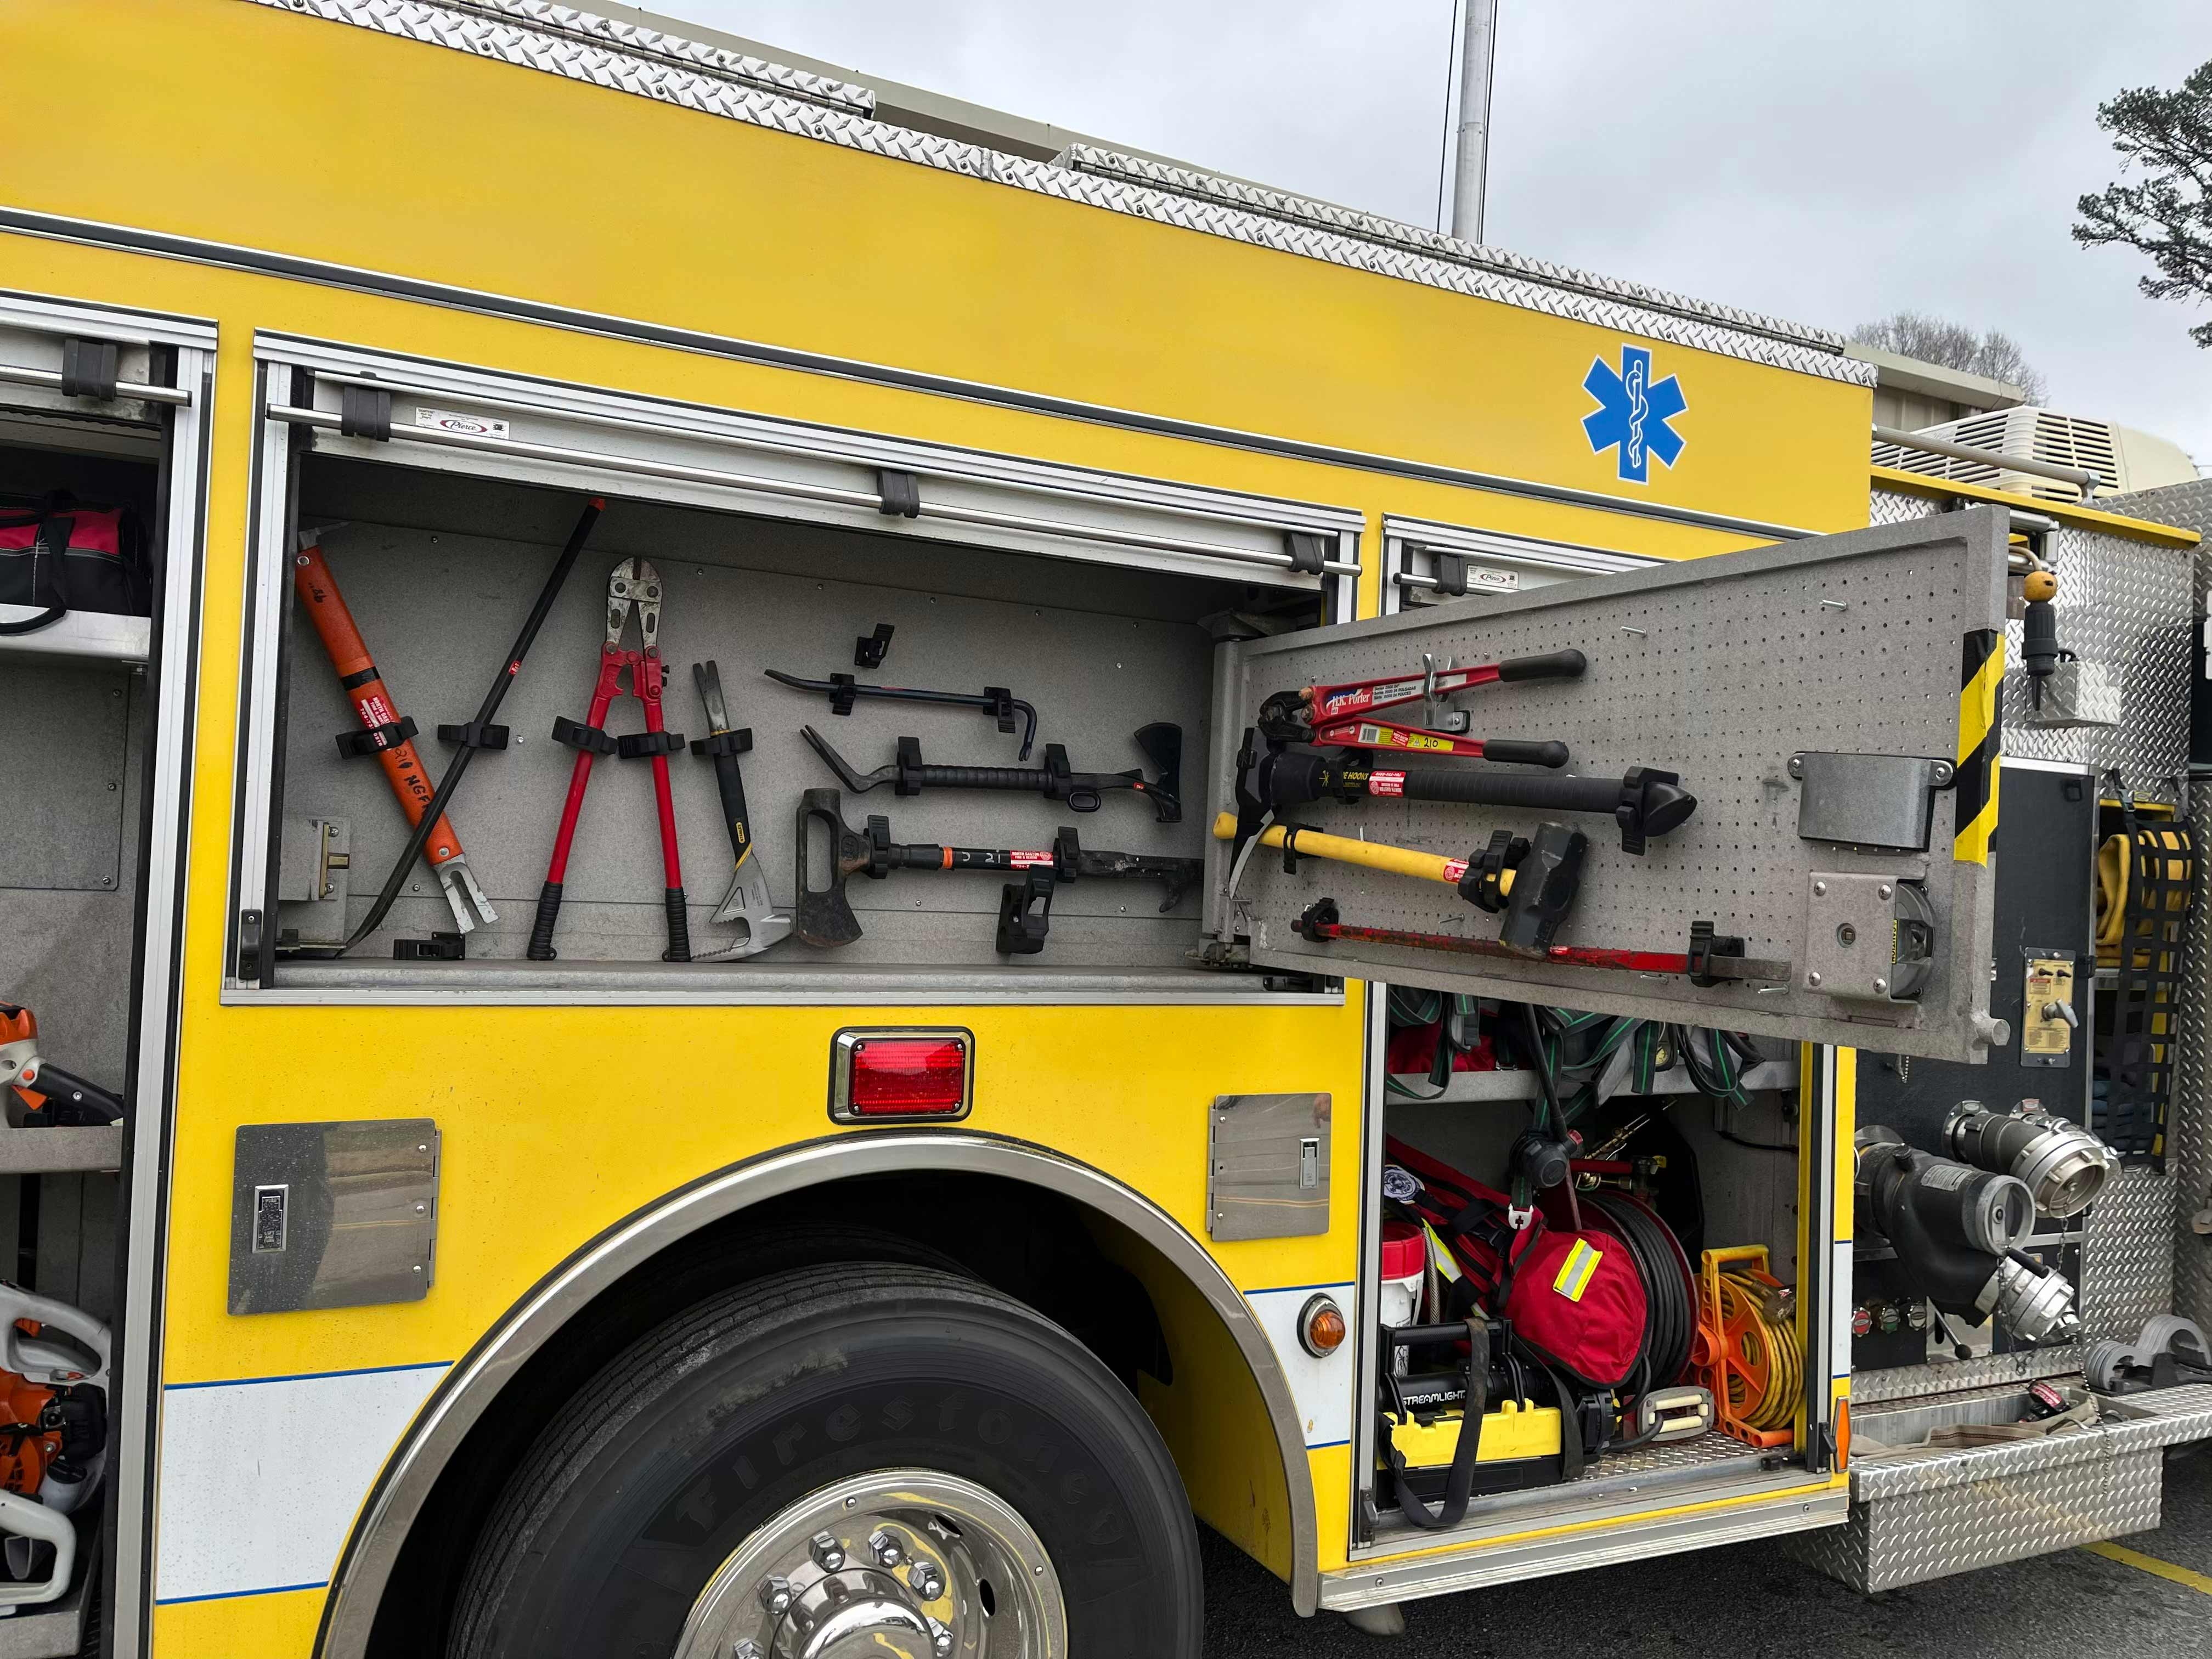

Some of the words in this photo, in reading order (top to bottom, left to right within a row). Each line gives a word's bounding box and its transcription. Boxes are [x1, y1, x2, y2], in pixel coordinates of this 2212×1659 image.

[450, 421, 476, 431] Pierce
[1348, 693, 1370, 706] Porter
[1424, 737, 1438, 747] 210
[1347, 771, 1369, 780] HOOKS
[1403, 1390, 1465, 1406] STREAMLIGHT
[677, 1393, 1090, 1531] Firestone
